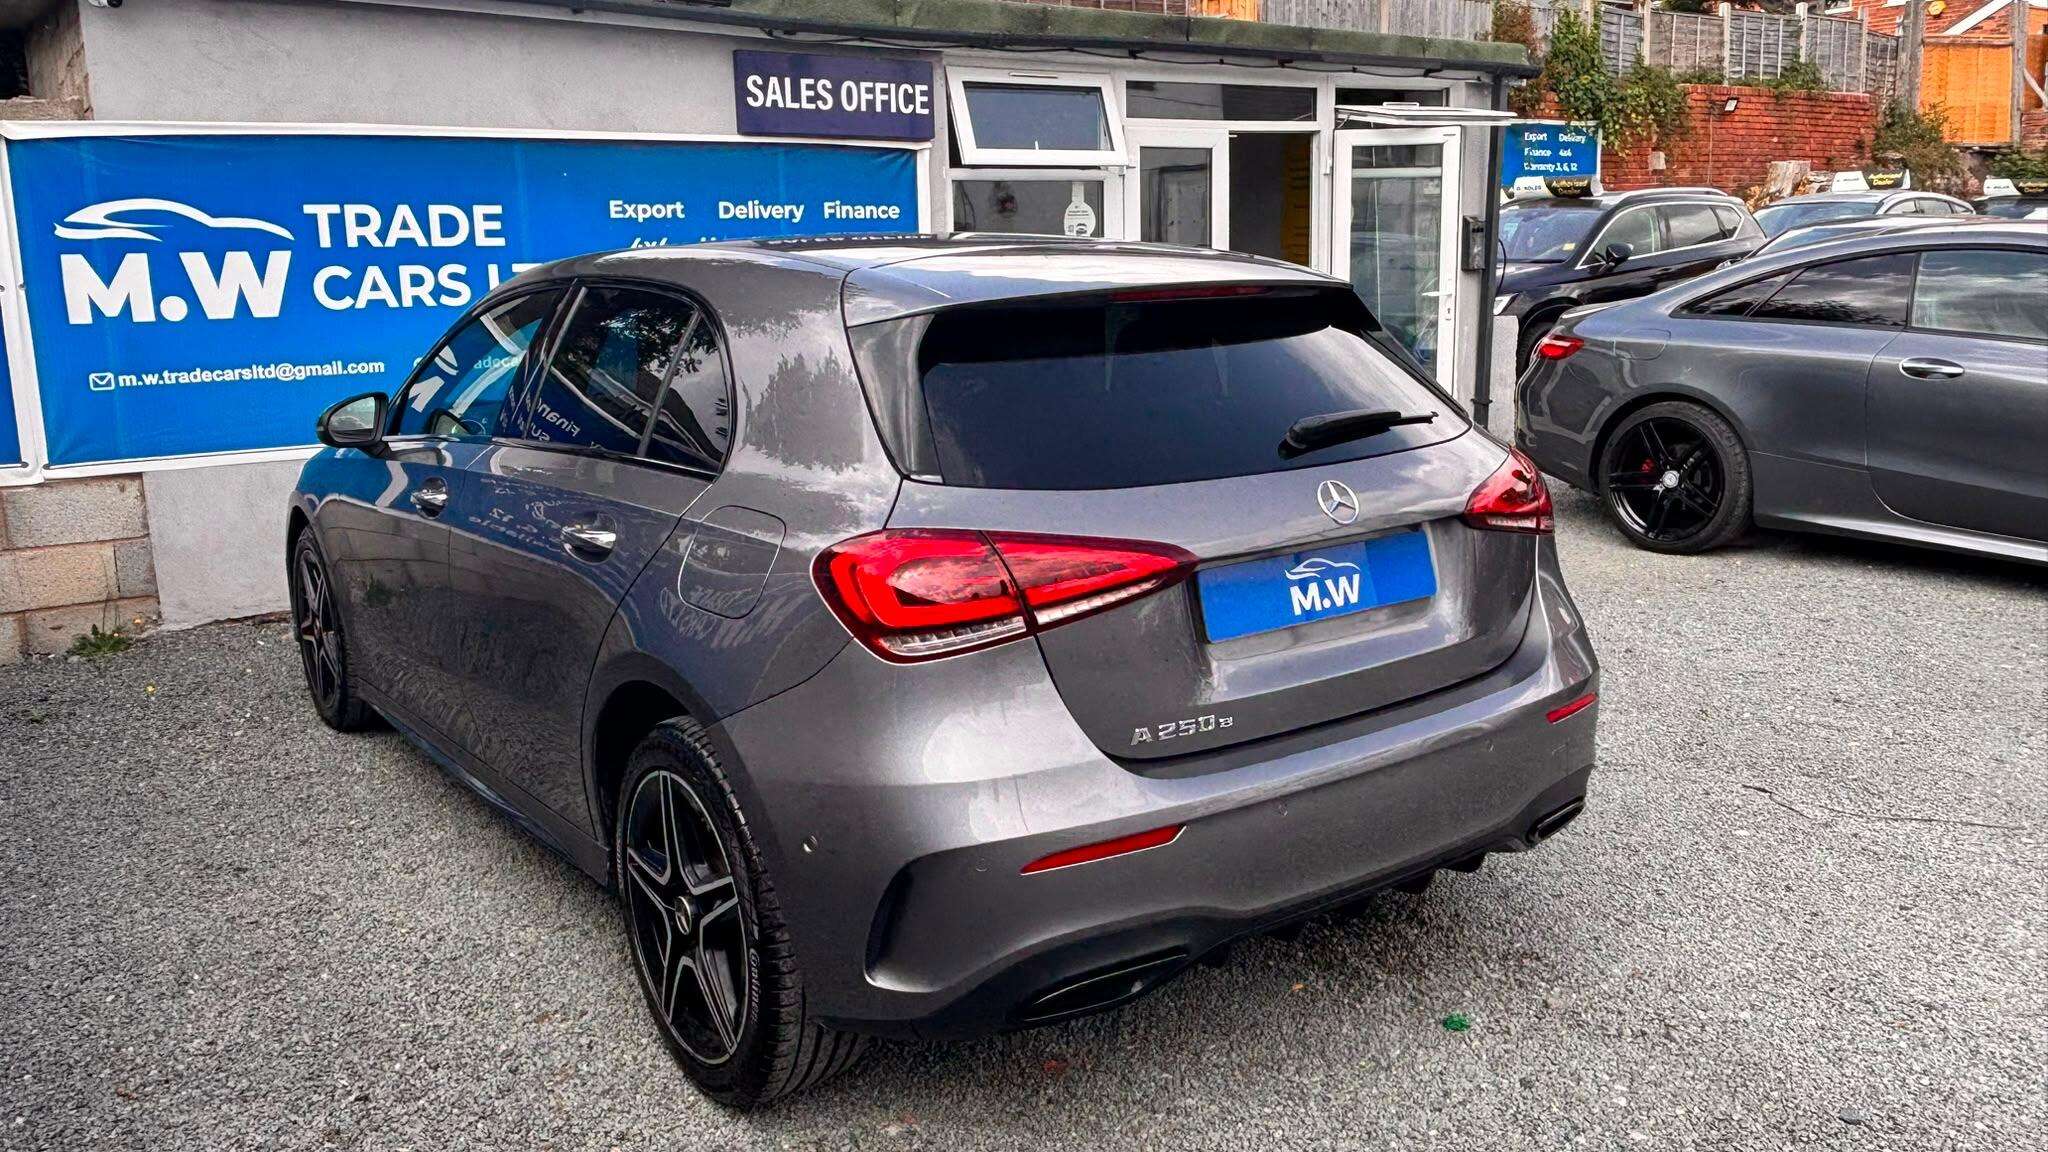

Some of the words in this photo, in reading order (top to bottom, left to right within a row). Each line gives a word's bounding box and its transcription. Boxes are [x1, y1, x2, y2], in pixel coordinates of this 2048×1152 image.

[746, 74, 833, 111] SALES
[840, 79, 930, 115] OFFICE
[1524, 132, 1548, 142] Export
[303, 203, 507, 249] TRADE
[609, 200, 685, 222] Export
[718, 200, 805, 223] Delivery
[823, 200, 901, 220] Finance
[60, 249, 292, 325] M.W
[312, 263, 472, 310] CARS
[118, 360, 385, 388] m.w.tradecarsltd@gmail.com
[1289, 573, 1361, 616] M.W
[1130, 727, 1154, 746] A
